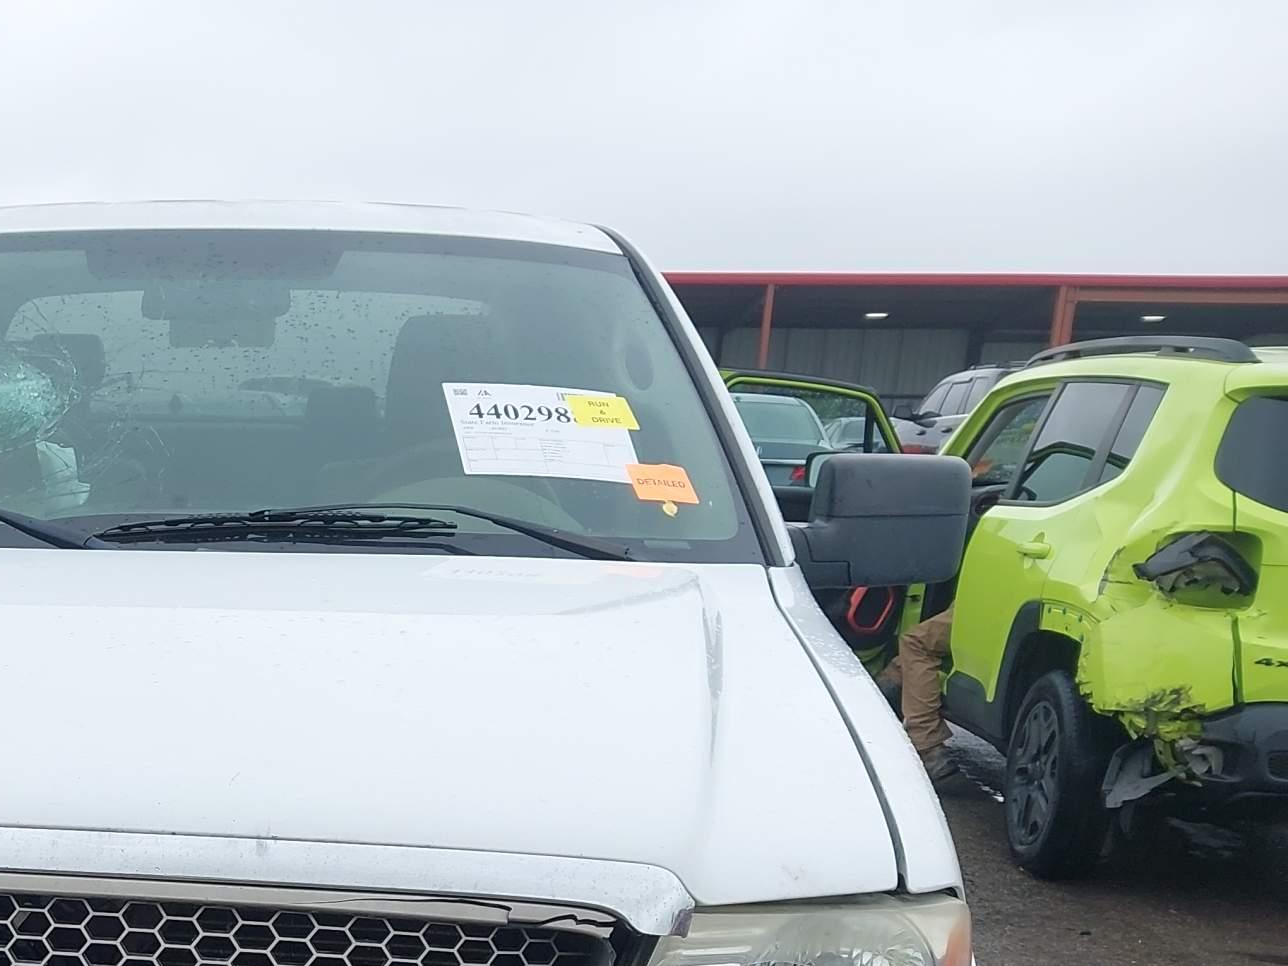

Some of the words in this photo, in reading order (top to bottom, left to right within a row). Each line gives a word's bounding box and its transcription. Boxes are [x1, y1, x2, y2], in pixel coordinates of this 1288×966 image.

[587, 400, 610, 408] RUN
[469, 403, 579, 423] 440298
[591, 416, 623, 424] DRIVE
[635, 477, 686, 489] DETAILED
[1253, 657, 1288, 668] 4x
